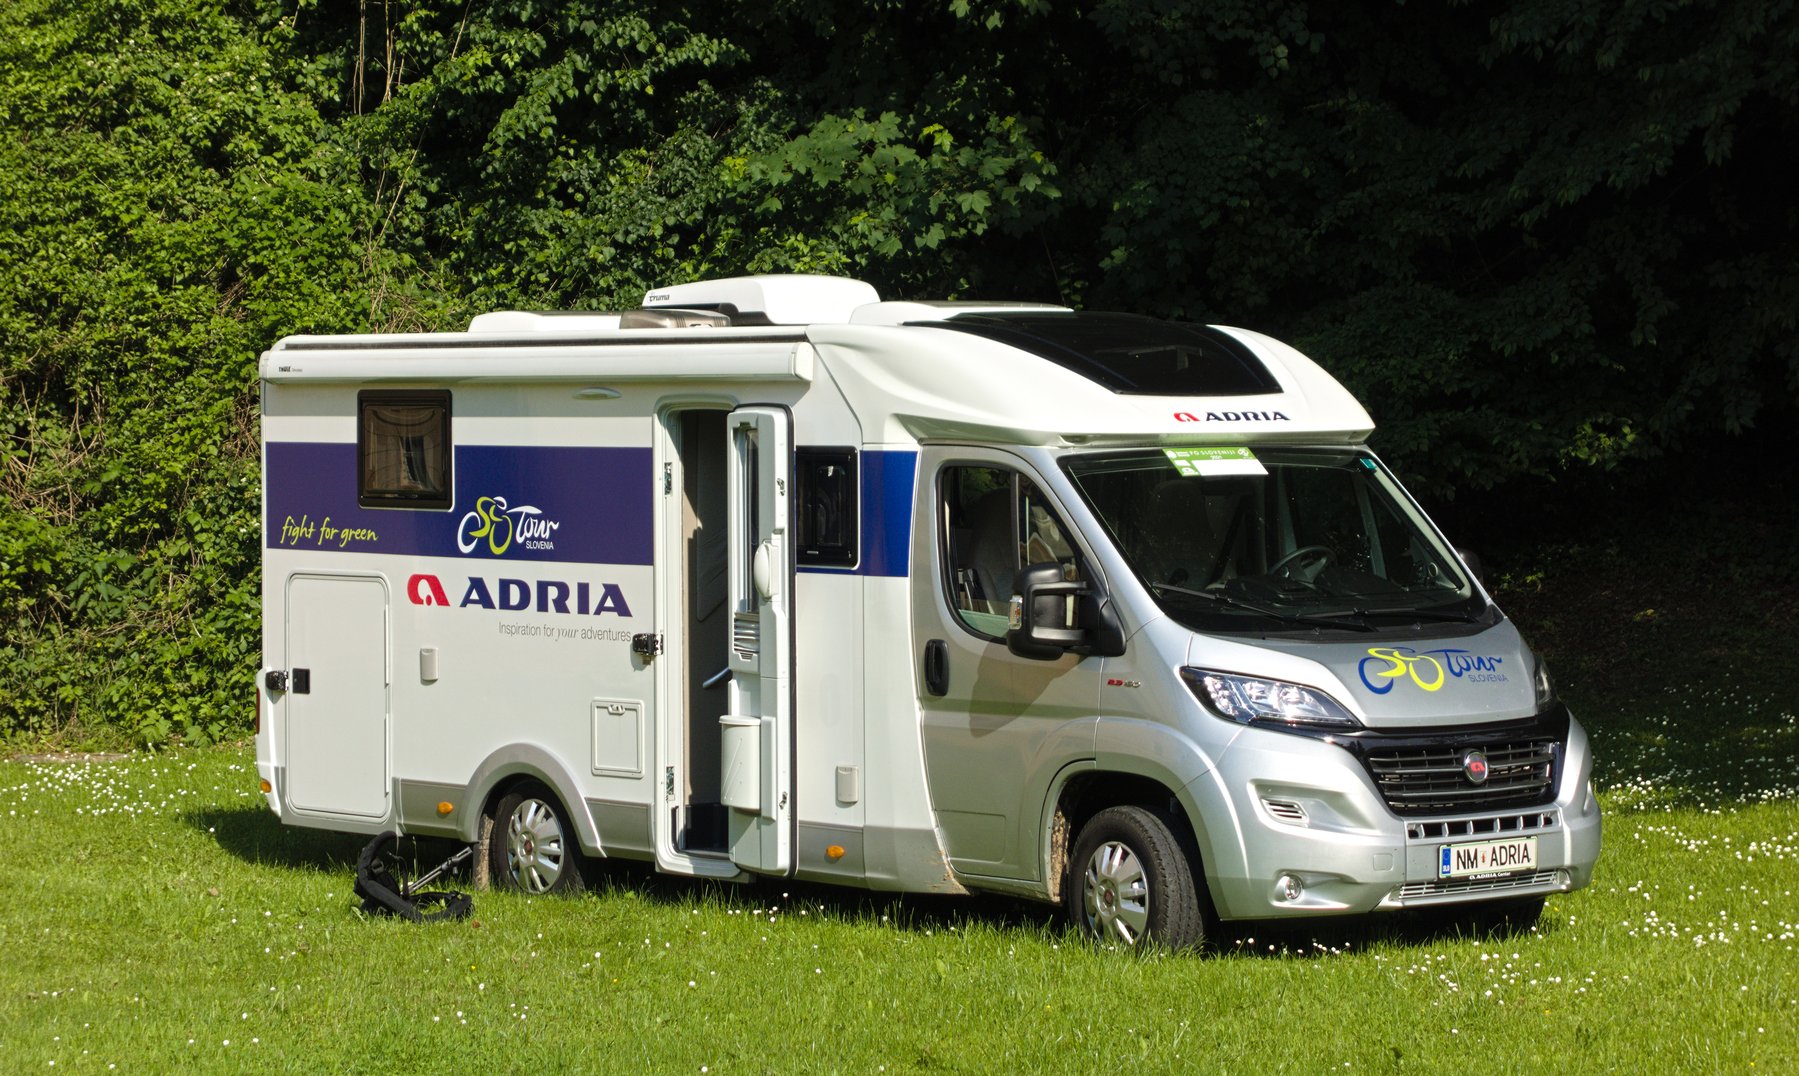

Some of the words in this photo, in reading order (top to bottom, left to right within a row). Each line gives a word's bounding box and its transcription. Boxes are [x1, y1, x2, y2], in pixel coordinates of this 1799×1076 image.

[1205, 411, 1291, 421] ADRIA
[280, 514, 316, 546] fight
[317, 516, 339, 546] for
[339, 528, 379, 548] green
[506, 505, 560, 544] Tour
[525, 540, 555, 550] SLOVENIA
[459, 576, 634, 618] ADRIA
[498, 621, 541, 637] Inspiration
[543, 624, 555, 637] for
[556, 628, 578, 642] your
[580, 628, 632, 643] adventures
[1421, 649, 1503, 678] Tour
[1468, 673, 1509, 683] SLOVENIA
[1456, 847, 1478, 871] NM
[1490, 843, 1531, 867] ADRIA
